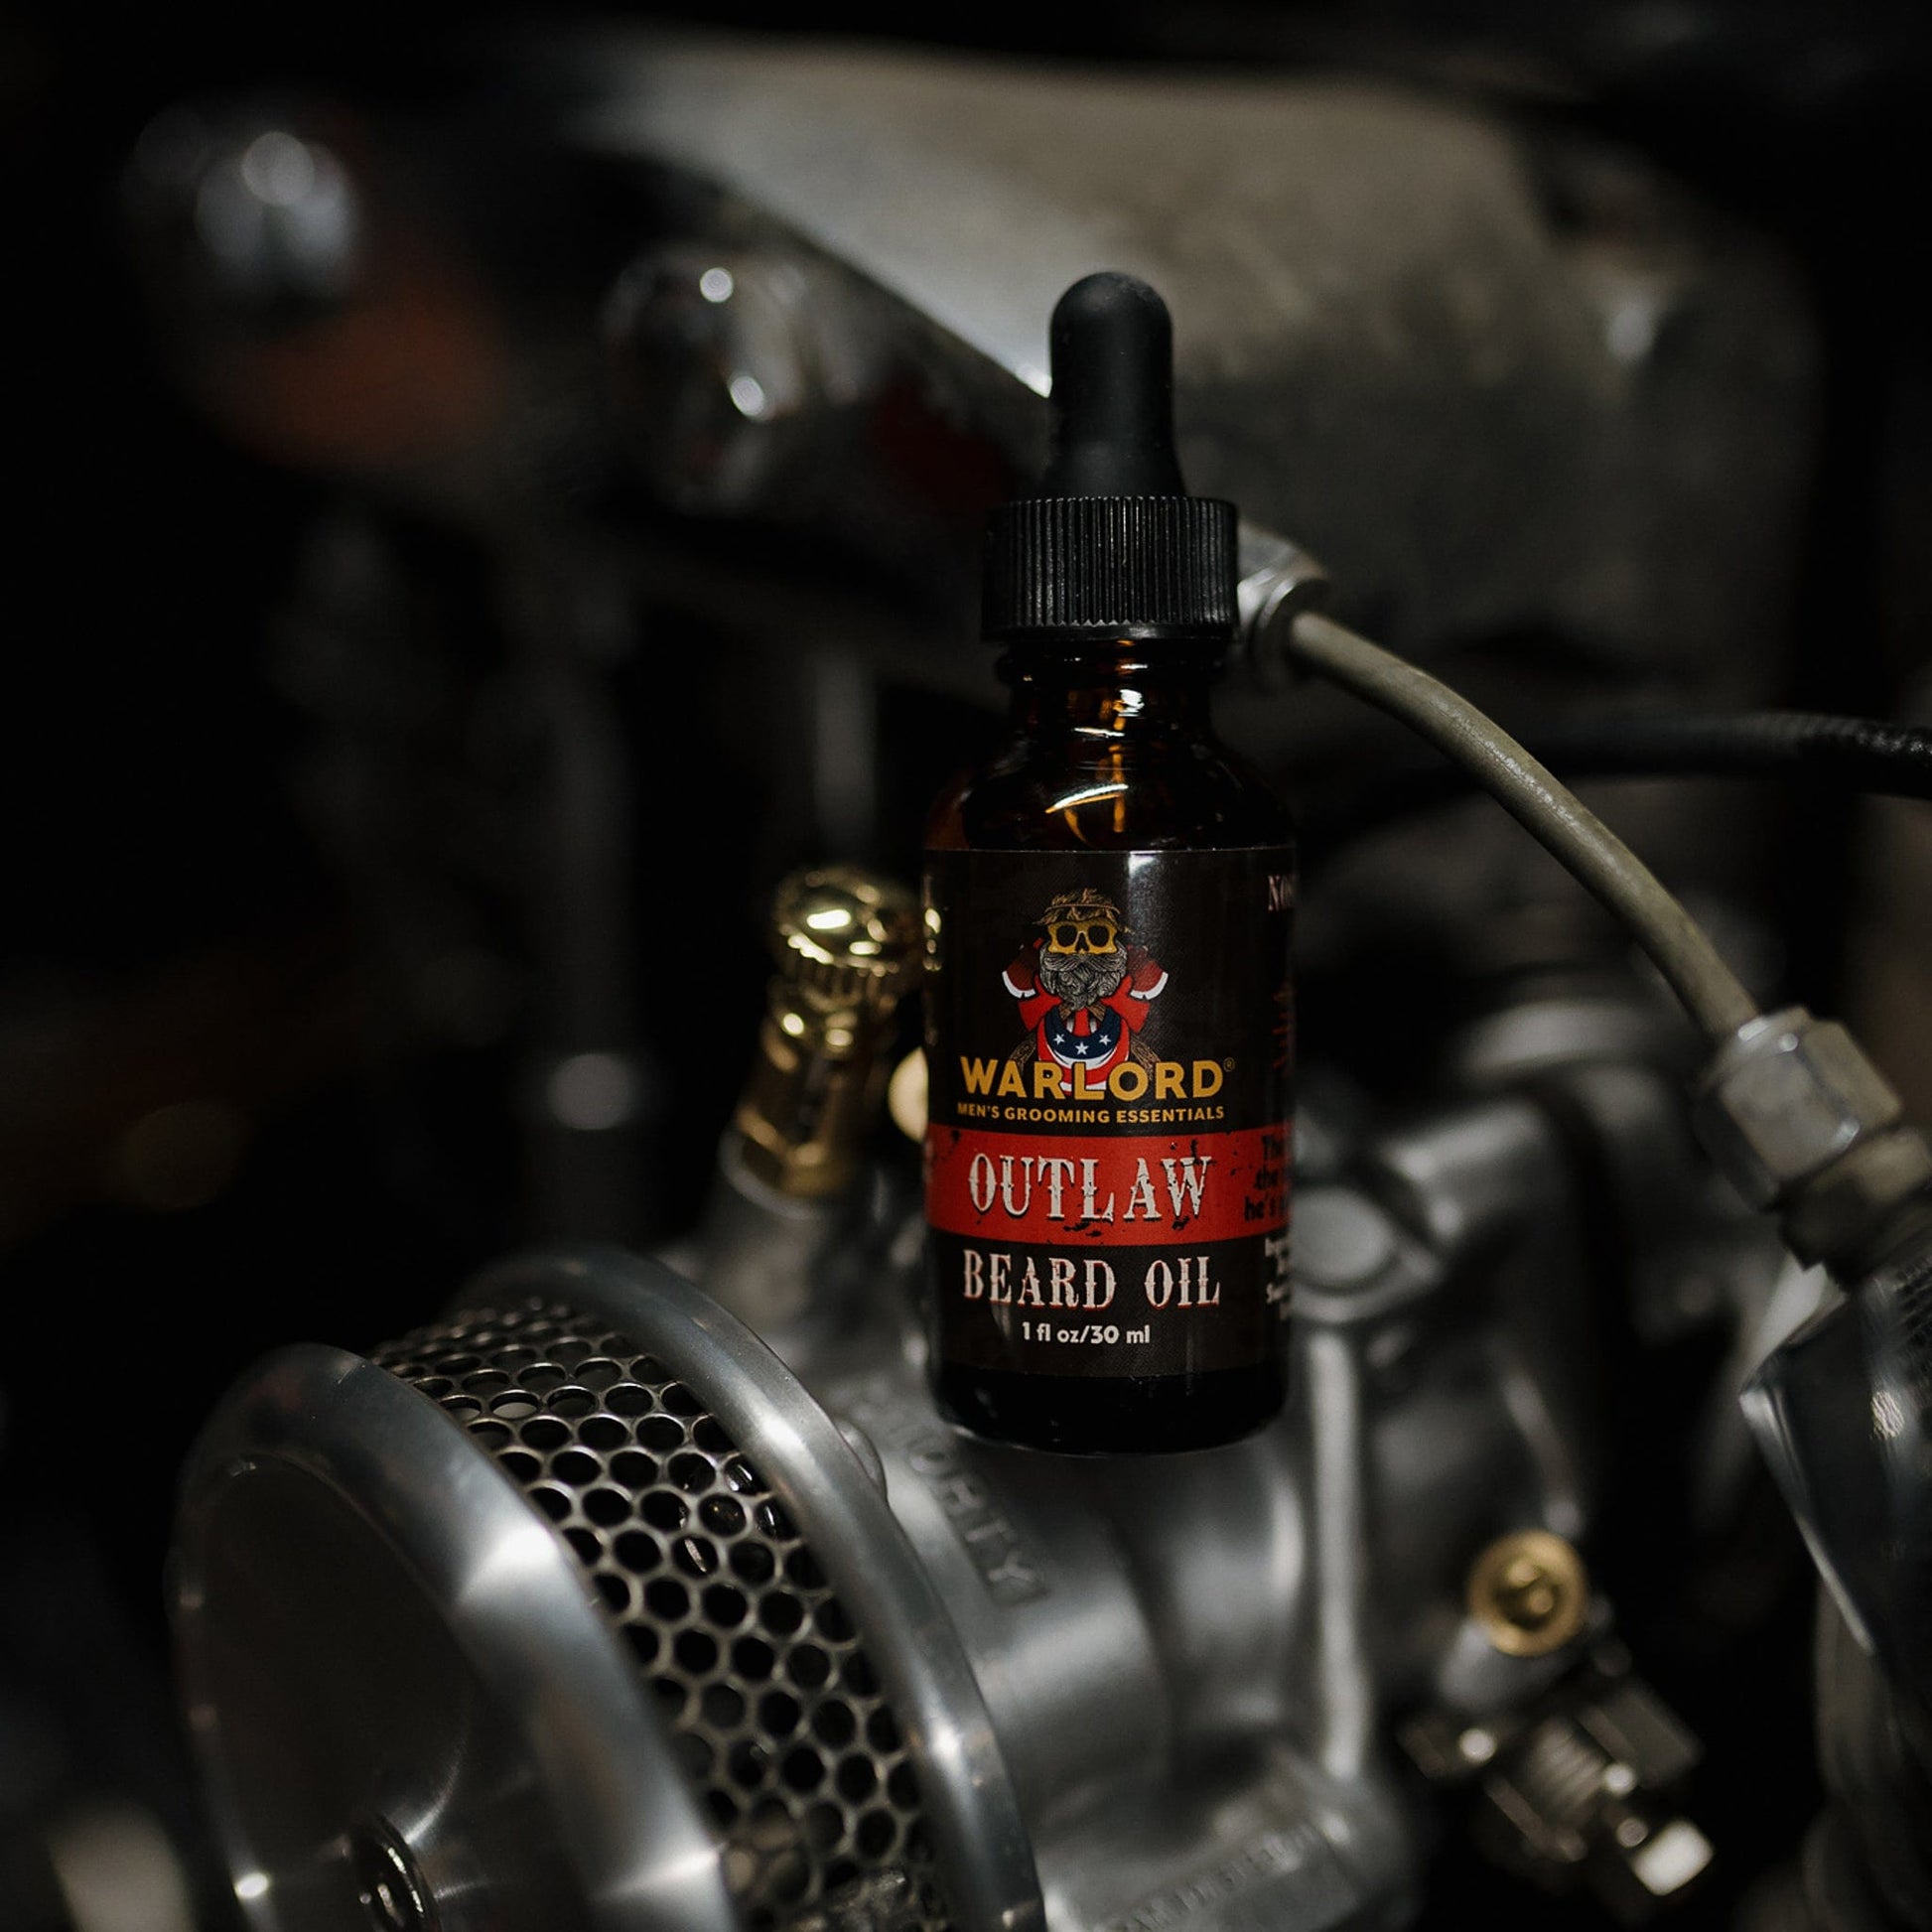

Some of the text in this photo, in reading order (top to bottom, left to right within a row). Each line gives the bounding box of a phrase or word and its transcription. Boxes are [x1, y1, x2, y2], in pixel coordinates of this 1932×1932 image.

[956, 1102, 1225, 1124] MEN'S GROOMING ESSENTIALS
[968, 1152, 1212, 1223] OUTLAW
[962, 1248, 1117, 1311] BEARD
[1144, 1255, 1222, 1310] OIL
[1022, 1320, 1152, 1344] 1 fl oz/30 ml
